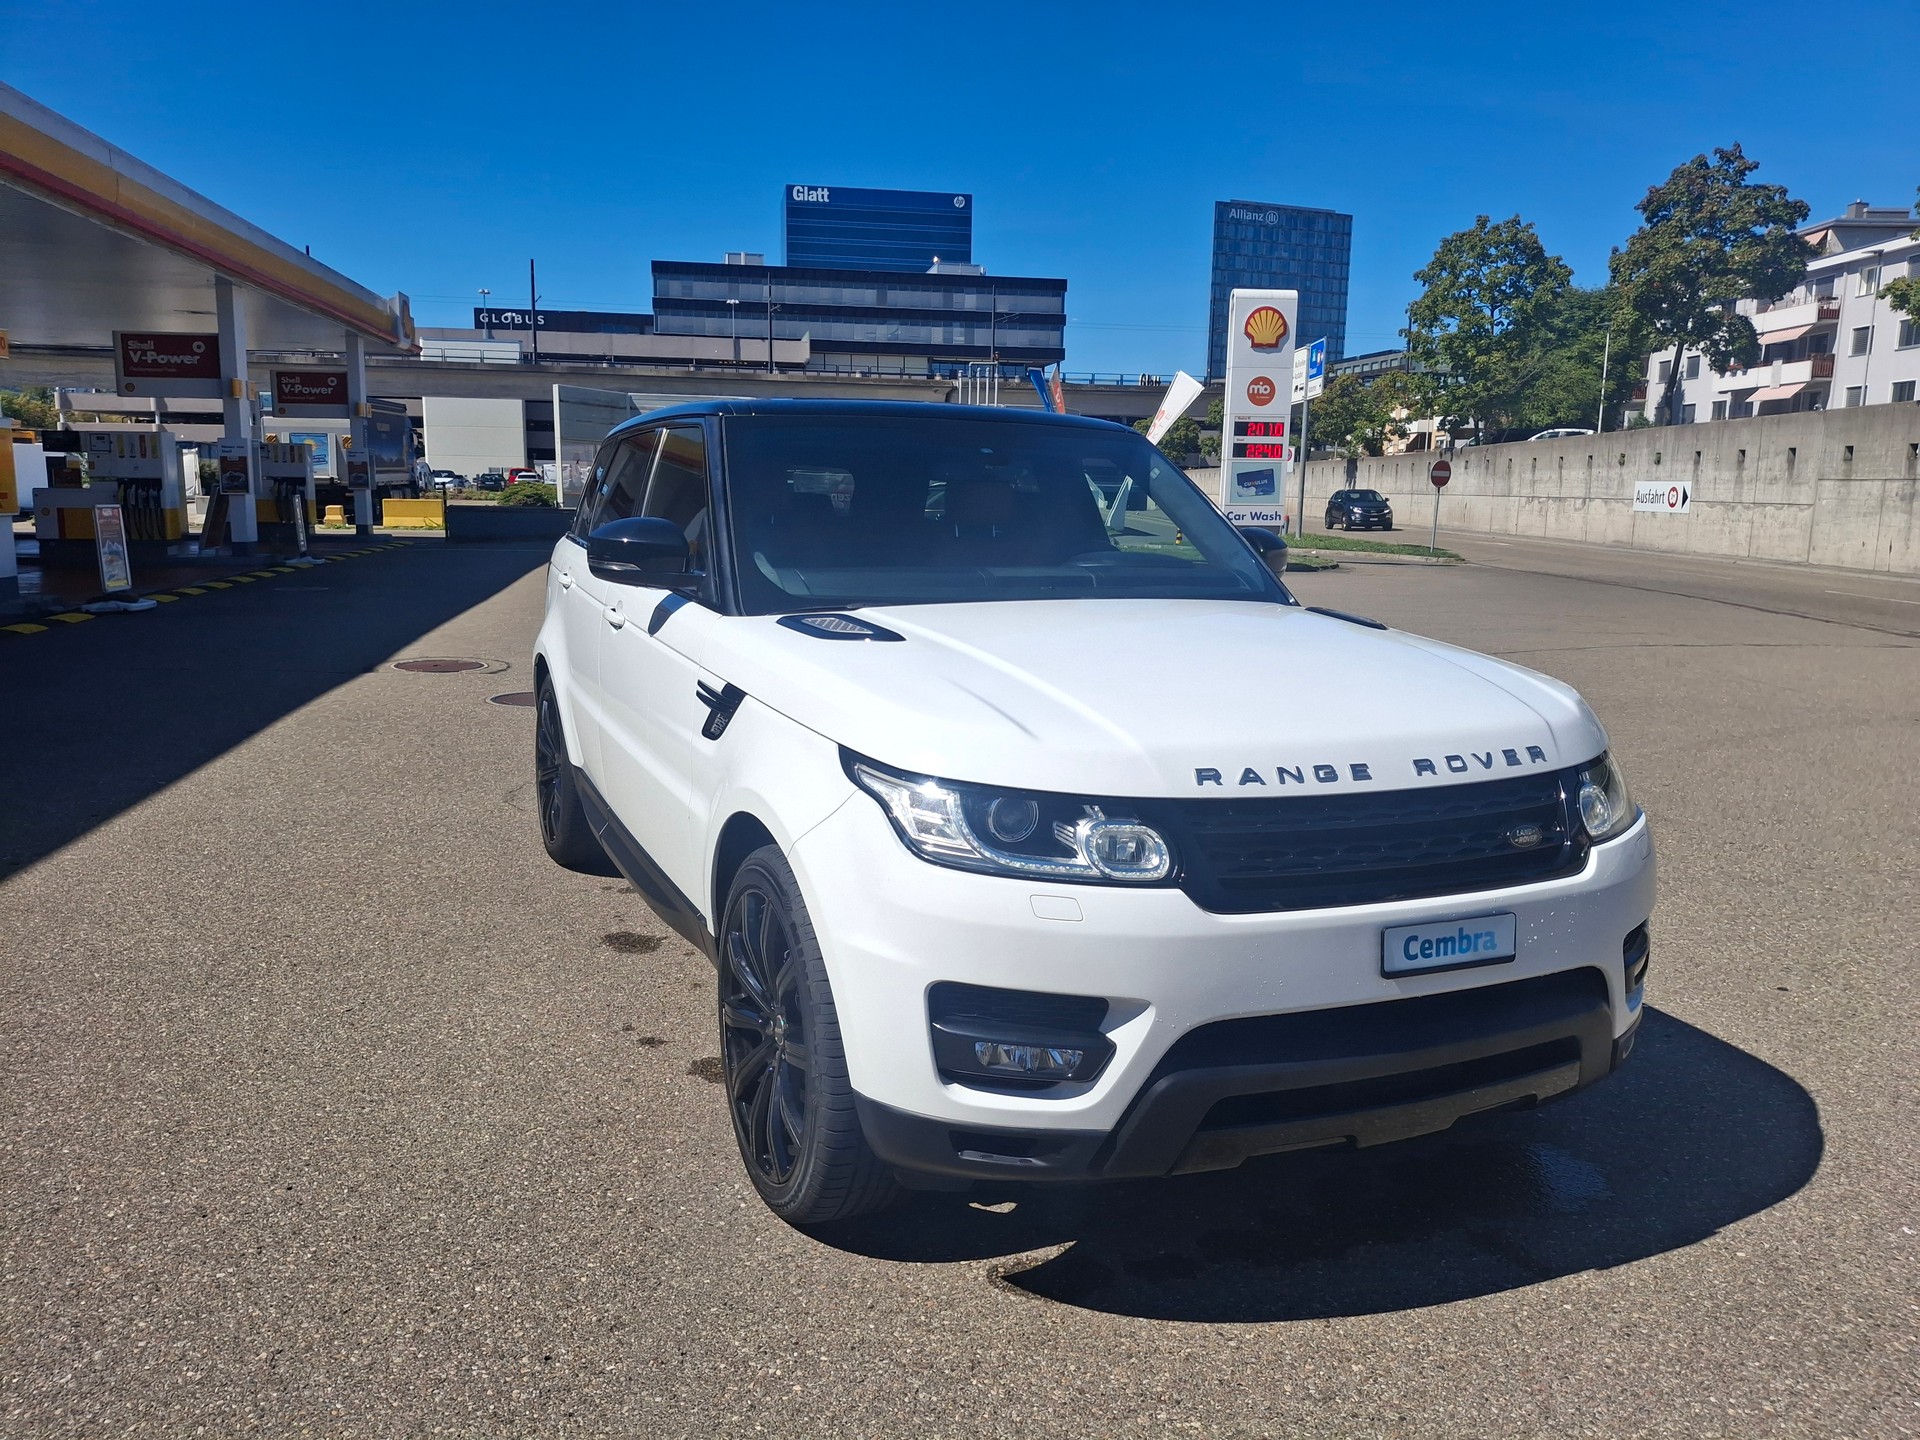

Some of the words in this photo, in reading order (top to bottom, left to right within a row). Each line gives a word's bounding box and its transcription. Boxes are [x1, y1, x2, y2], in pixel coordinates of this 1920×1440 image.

[793, 185, 830, 203] Glatt
[1229, 208, 1264, 221] Allianz
[479, 312, 545, 325] GLOBUS
[127, 340, 154, 350] Shell
[129, 350, 200, 364] V-Power
[281, 375, 300, 384] Shell
[282, 384, 334, 395] V-Power
[1249, 381, 1270, 394] mio
[1636, 489, 1665, 504] Ausfahrt
[1226, 511, 1247, 521] Car
[1249, 510, 1282, 521] Wash
[1194, 763, 1373, 787] RANGE
[1412, 745, 1548, 777] ROVER
[1403, 927, 1498, 961] Cembra
